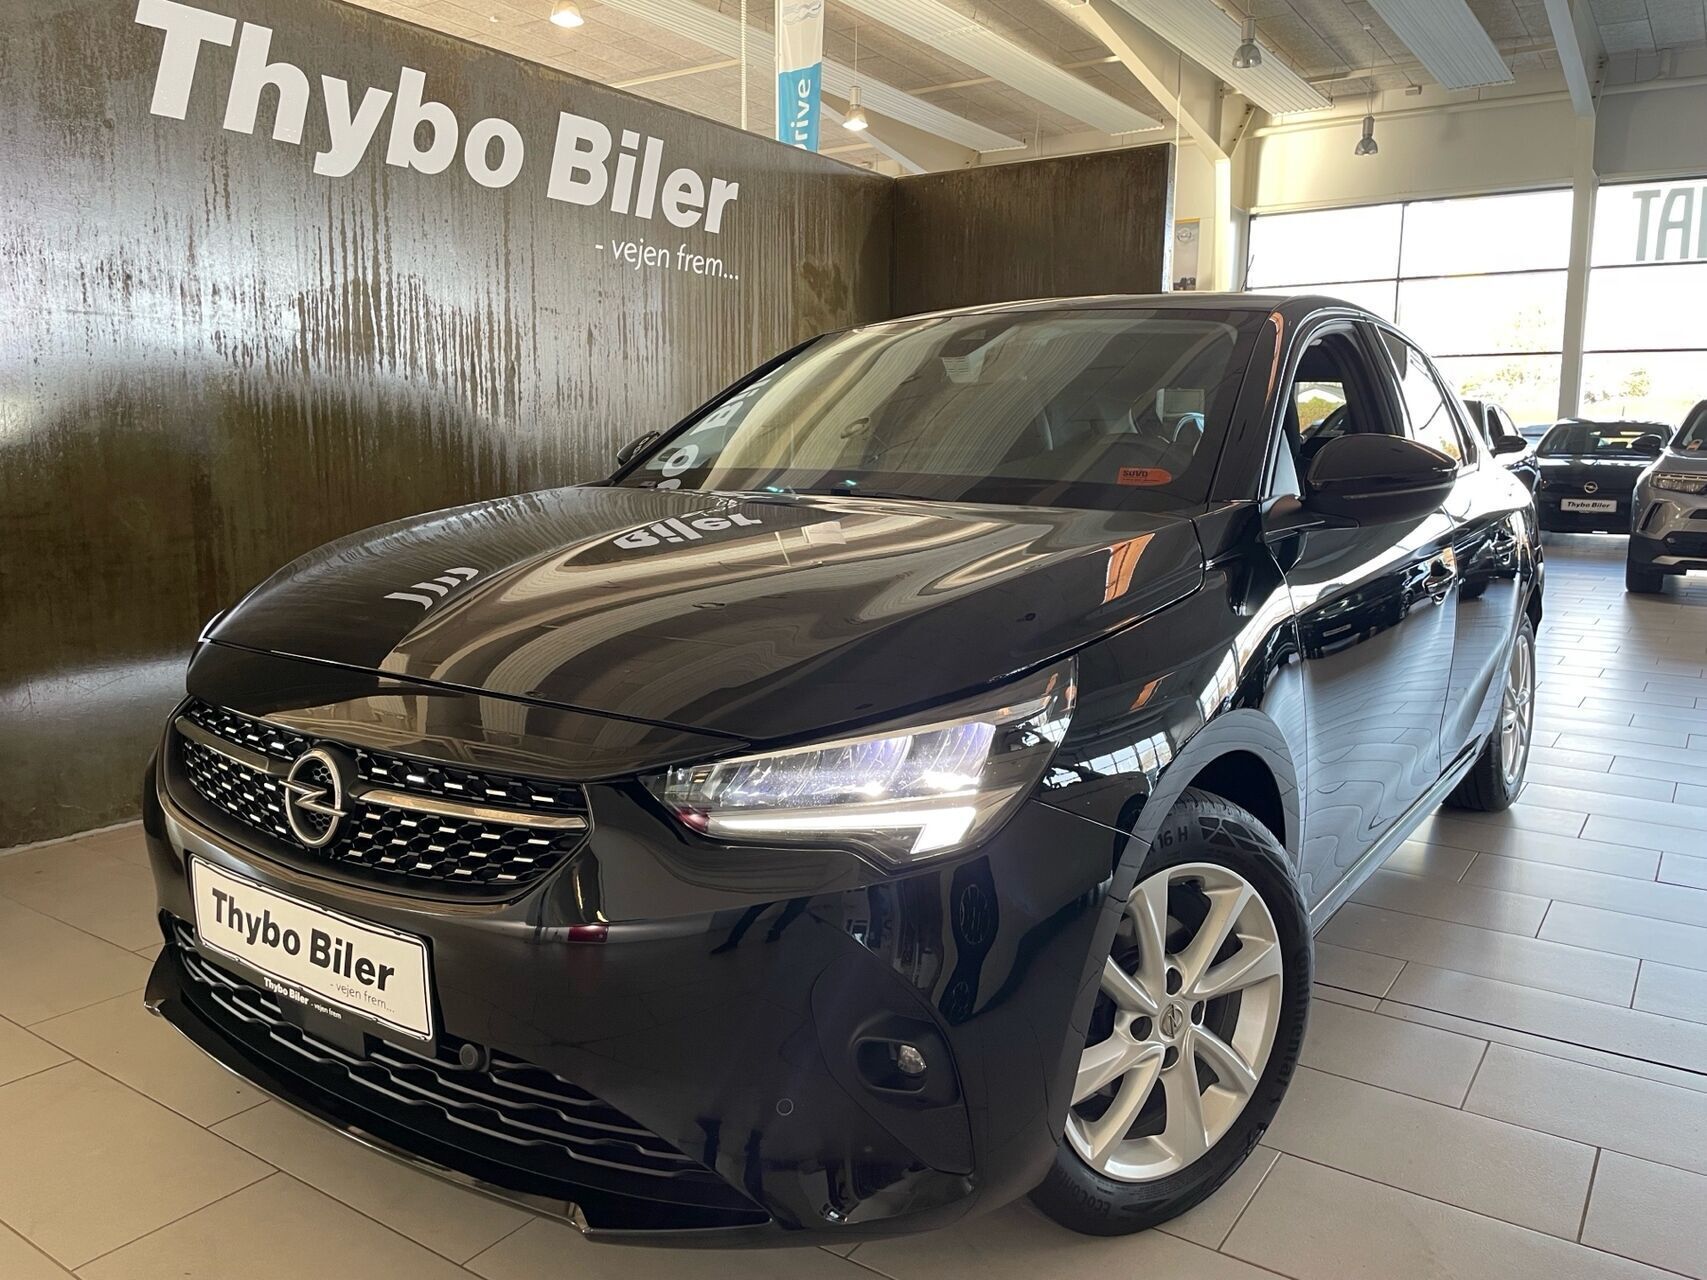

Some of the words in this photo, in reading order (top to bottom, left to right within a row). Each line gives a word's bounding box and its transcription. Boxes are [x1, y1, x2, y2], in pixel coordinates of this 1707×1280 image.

[134, 0, 525, 188] Thybo
[546, 111, 739, 234] Biler
[790, 79, 811, 150] rive
[612, 238, 670, 271] vejen
[211, 887, 301, 956] Thybo
[309, 928, 395, 992] Biler
[263, 976, 288, 996] Thybo
[289, 987, 310, 1006] Biler
[335, 982, 361, 999] vejen
